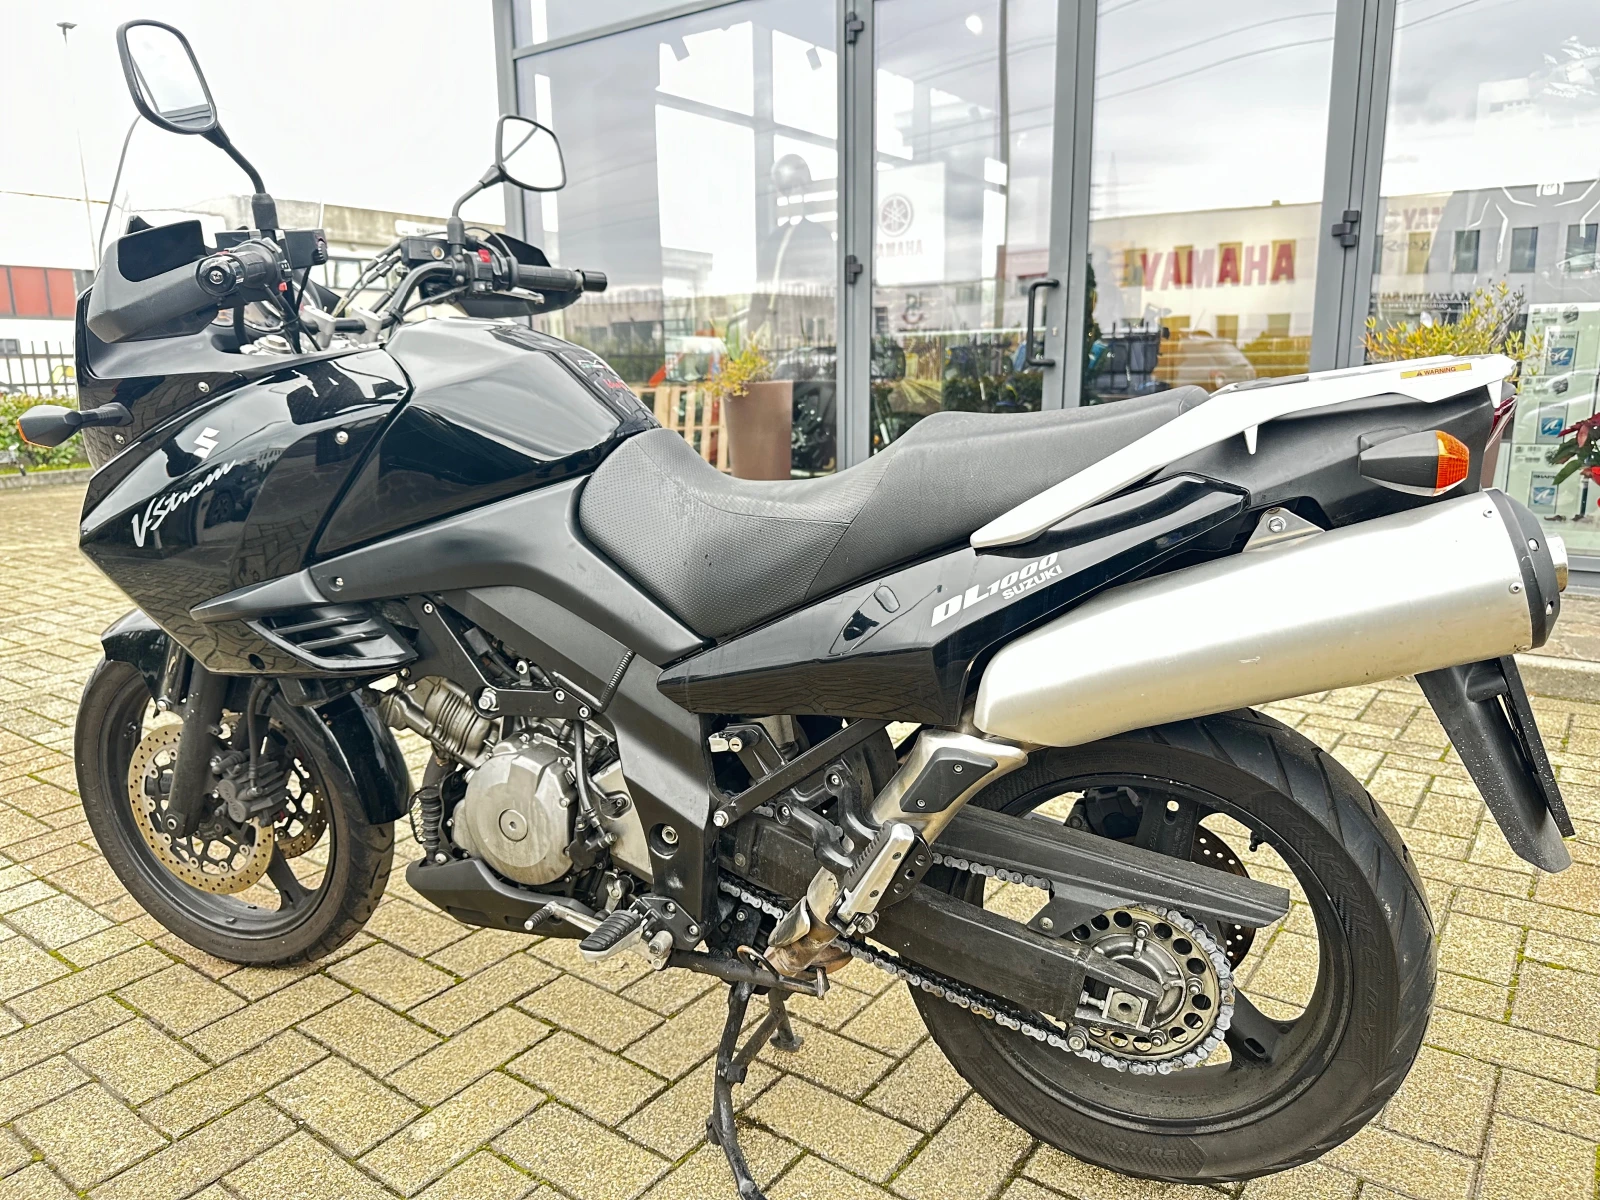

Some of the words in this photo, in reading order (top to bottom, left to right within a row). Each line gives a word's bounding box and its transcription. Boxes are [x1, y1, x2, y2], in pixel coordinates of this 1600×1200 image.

[876, 239, 923, 258] AMAHA
[1140, 243, 1296, 291] YAMAHA
[1424, 366, 1456, 376] WARNING
[931, 552, 1059, 627] DL1000
[1001, 564, 1063, 600] SUZUKI
